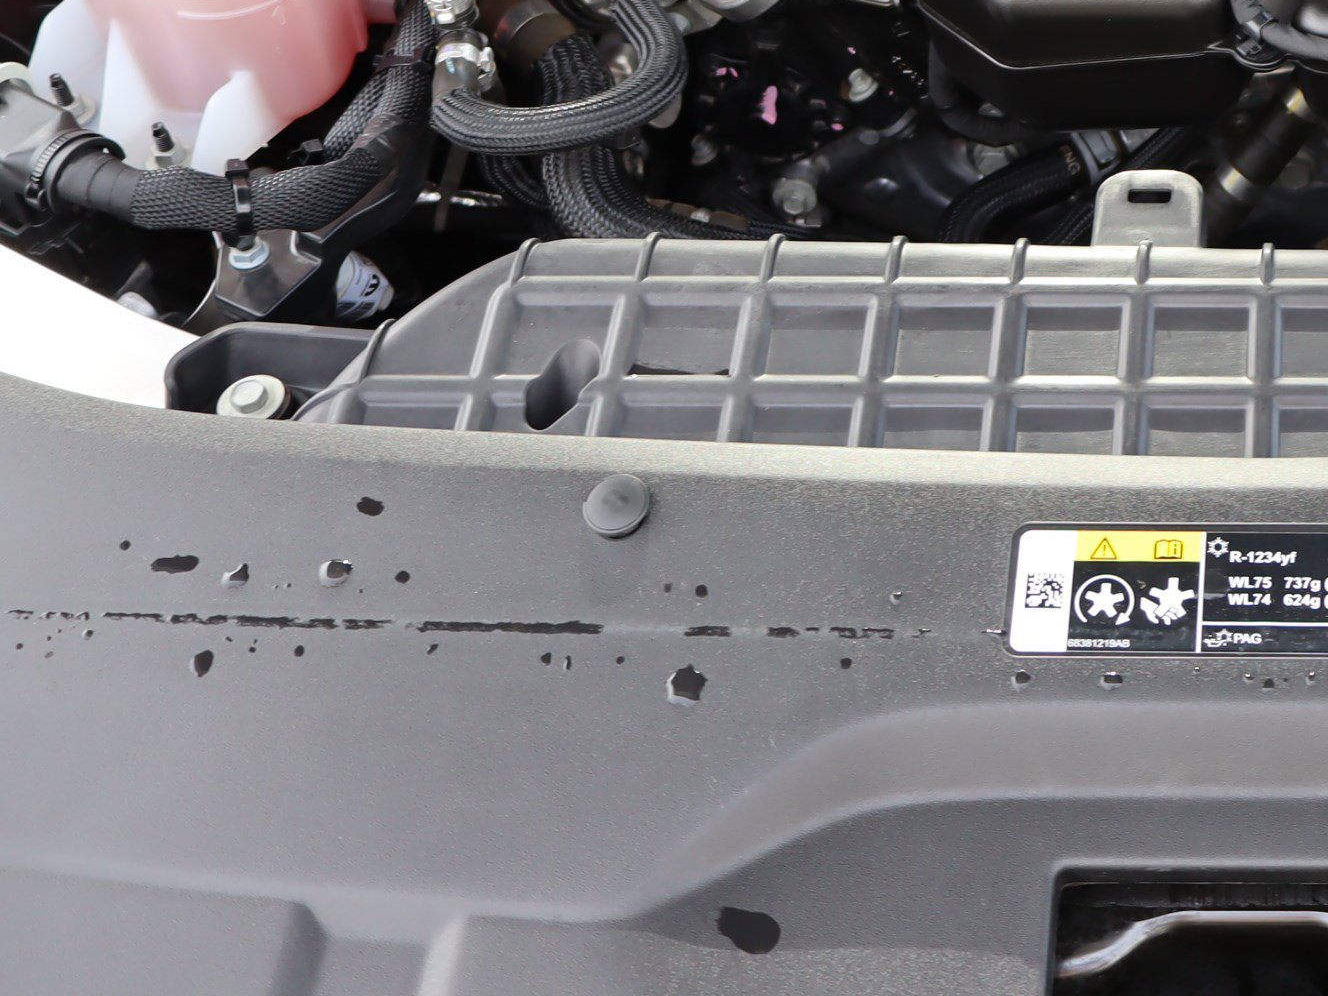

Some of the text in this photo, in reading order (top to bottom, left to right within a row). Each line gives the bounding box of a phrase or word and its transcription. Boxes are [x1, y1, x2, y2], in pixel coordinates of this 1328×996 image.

[1229, 550, 1298, 566] R-1234yf
[1228, 576, 1272, 588] WL75
[1283, 576, 1321, 592] 737g
[1227, 593, 1272, 606] WL74
[1283, 593, 1321, 609] 624g
[1233, 632, 1262, 644] PAG
